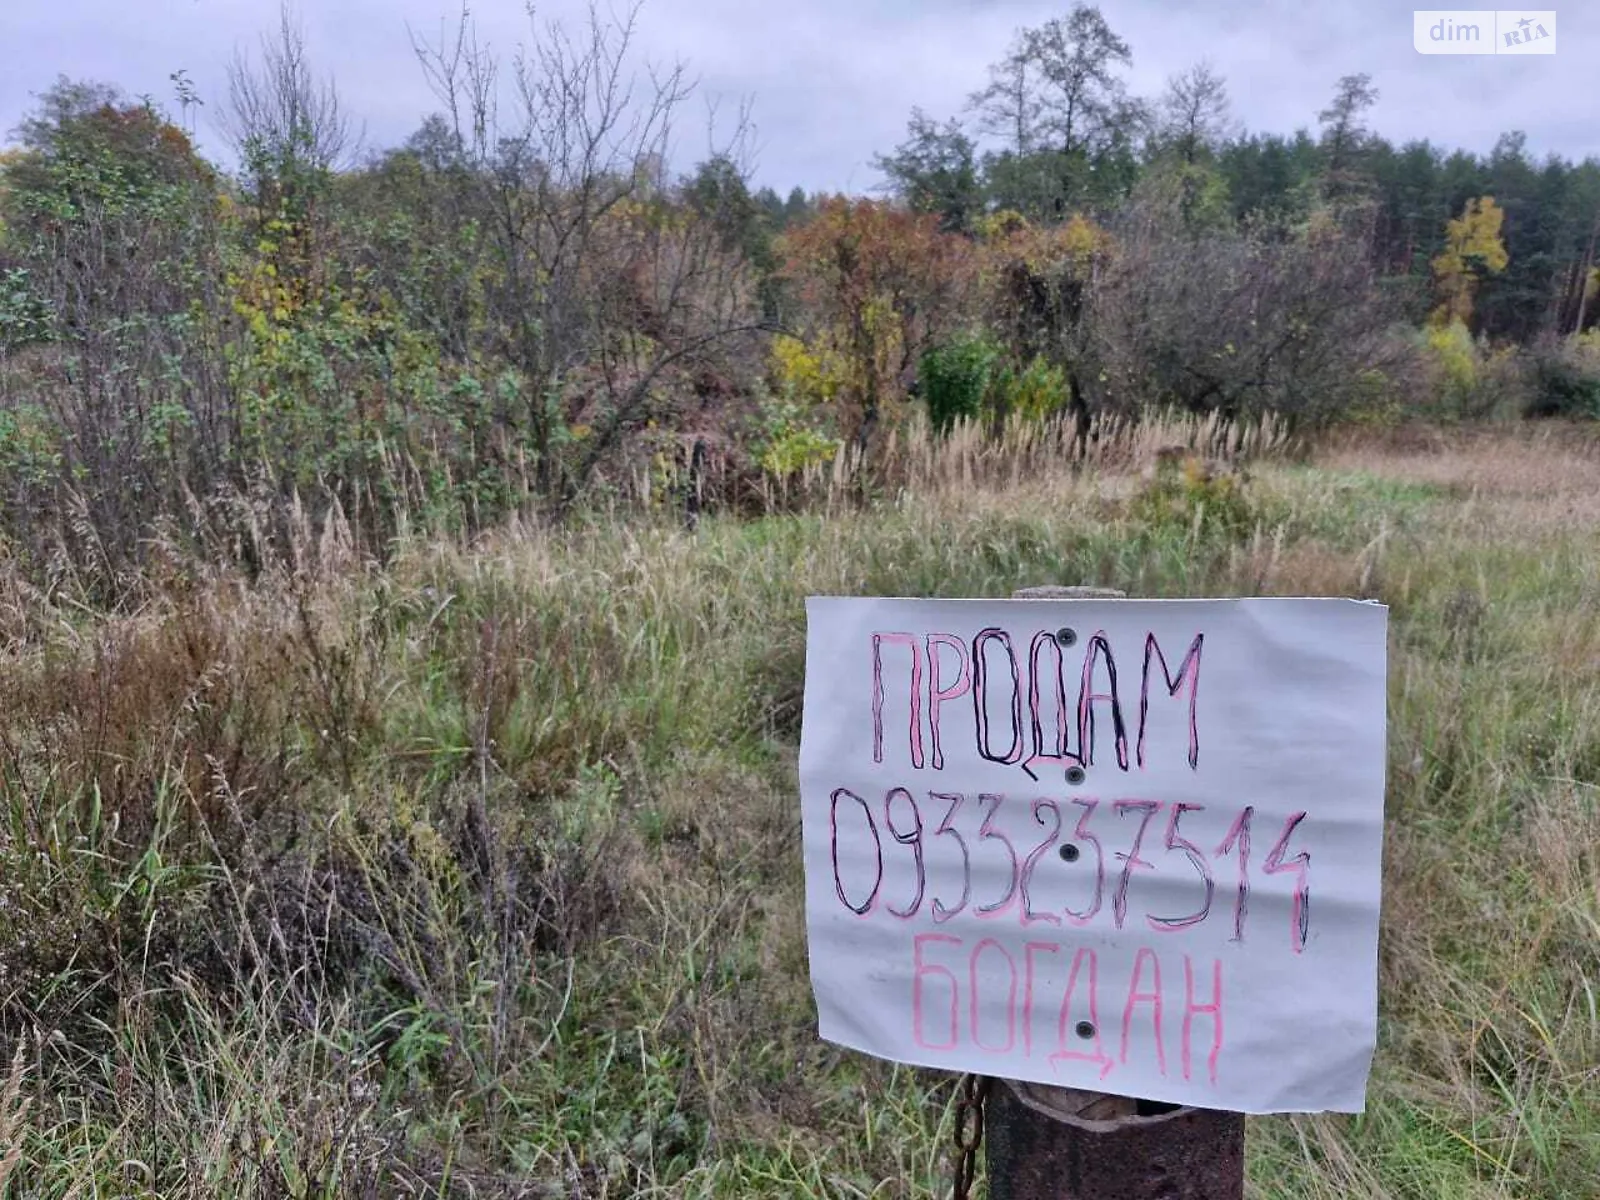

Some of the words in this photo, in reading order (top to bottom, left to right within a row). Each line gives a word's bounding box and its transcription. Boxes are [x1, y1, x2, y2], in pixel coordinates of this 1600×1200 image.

[871, 628, 1204, 781] ПРОДАМ
[830, 786, 1311, 955] 0933237514
[912, 933, 1224, 1086] БОГДАН
